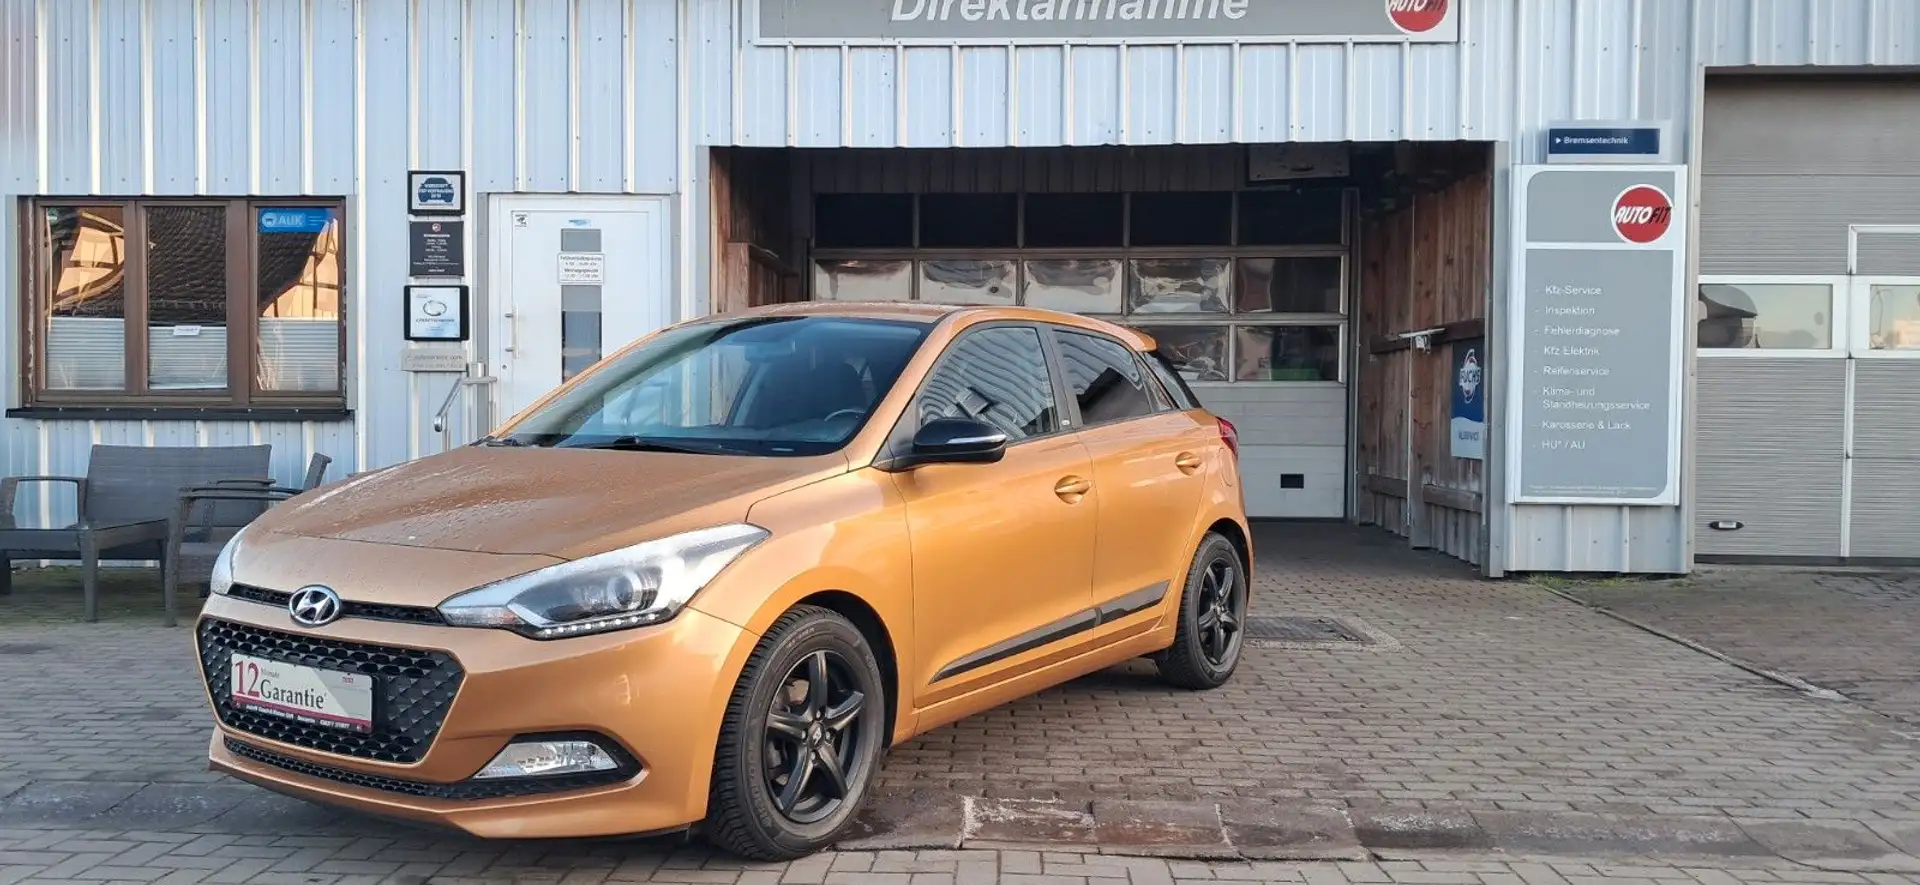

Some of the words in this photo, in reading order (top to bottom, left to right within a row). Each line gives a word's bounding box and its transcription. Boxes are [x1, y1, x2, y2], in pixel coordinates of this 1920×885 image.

[1563, 136, 1629, 145] Bremsentechnik
[1614, 206, 1673, 224] AUTOFIT
[1545, 285, 1602, 296] Kfz-Service
[1545, 306, 1595, 316] Inspektion
[1544, 325, 1620, 337] Fehlerdiagnose
[1542, 365, 1610, 376] Reifenservice
[1542, 386, 1574, 396] Klima-
[1577, 387, 1595, 396] und
[1542, 400, 1651, 411] Standheizungsservice
[1541, 420, 1595, 430] Karosserie
[1597, 420, 1604, 430] &
[1608, 421, 1631, 431] Lack
[1570, 441, 1586, 450] AU
[235, 660, 260, 698] 12
[260, 678, 325, 709] Garantie
